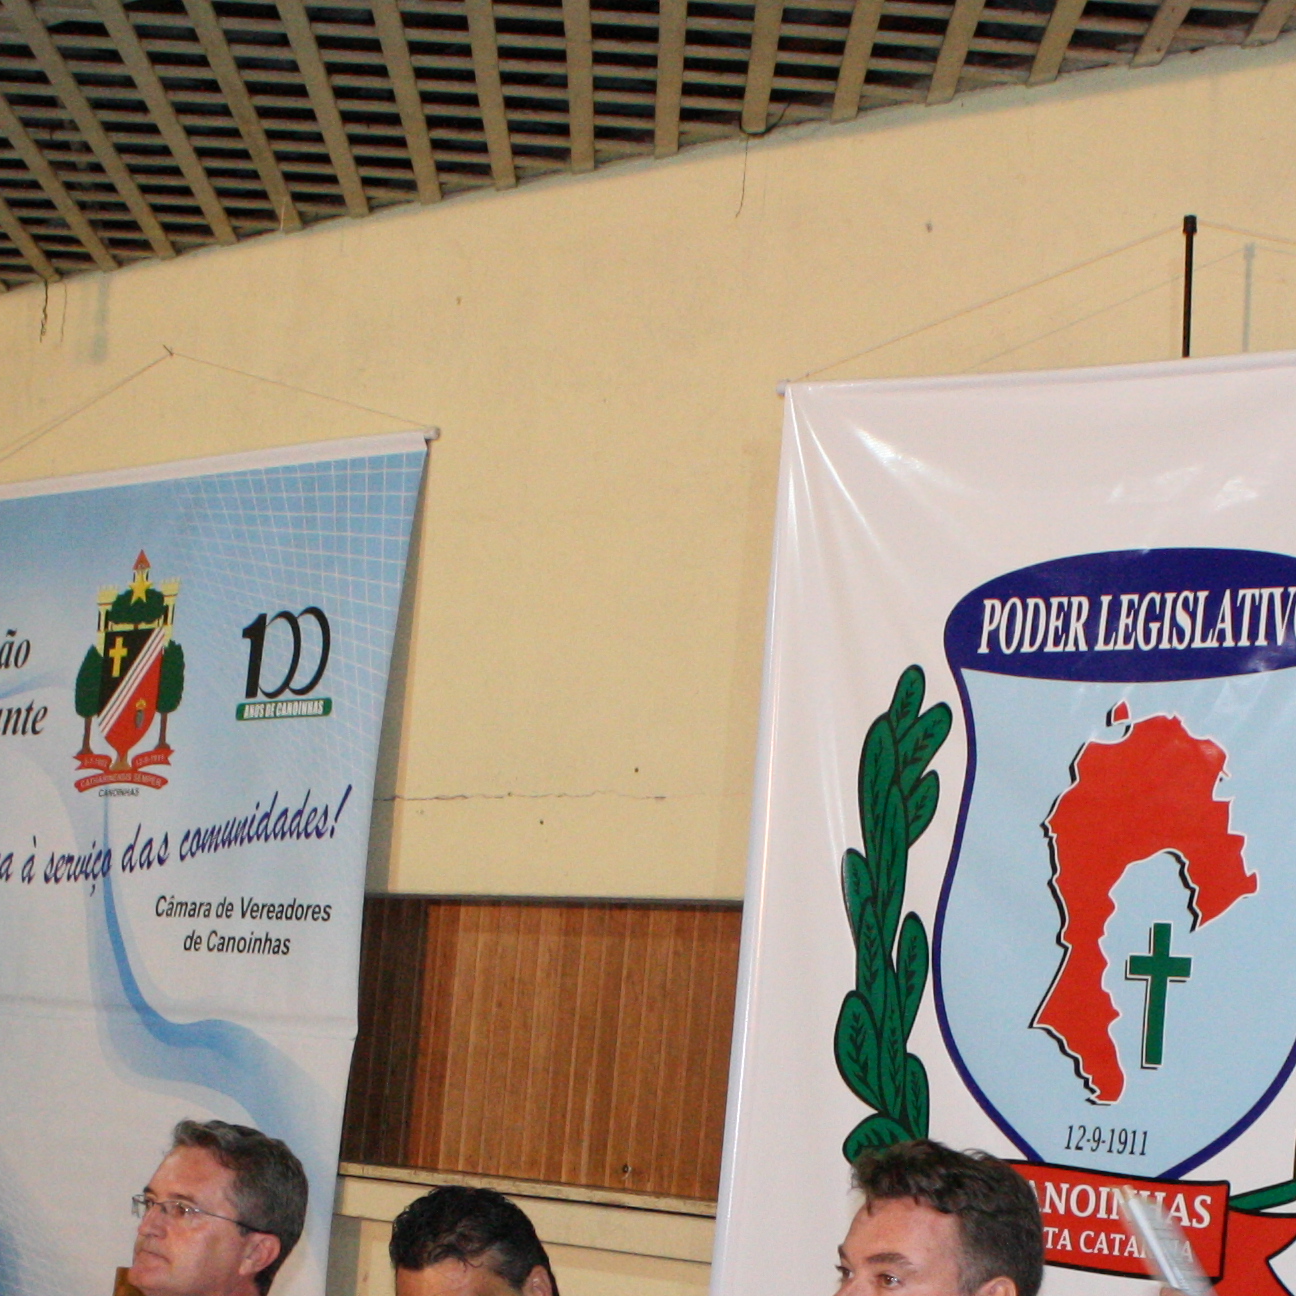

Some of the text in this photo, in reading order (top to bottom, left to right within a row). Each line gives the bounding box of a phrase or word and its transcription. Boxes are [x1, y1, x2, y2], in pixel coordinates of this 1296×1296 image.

[978, 594, 1090, 655] PODER
[242, 606, 331, 699] 100
[243, 700, 324, 719] ANOS DE CANOINHAS
[21, 835, 36, 885] à
[43, 840, 112, 897] serviço
[121, 822, 170, 873] das
[179, 784, 352, 861] comunidades!
[155, 895, 332, 922] Câmara de Vereadores
[183, 930, 291, 956] de Canoinhas
[1064, 1124, 1148, 1156] 12-9-1911
